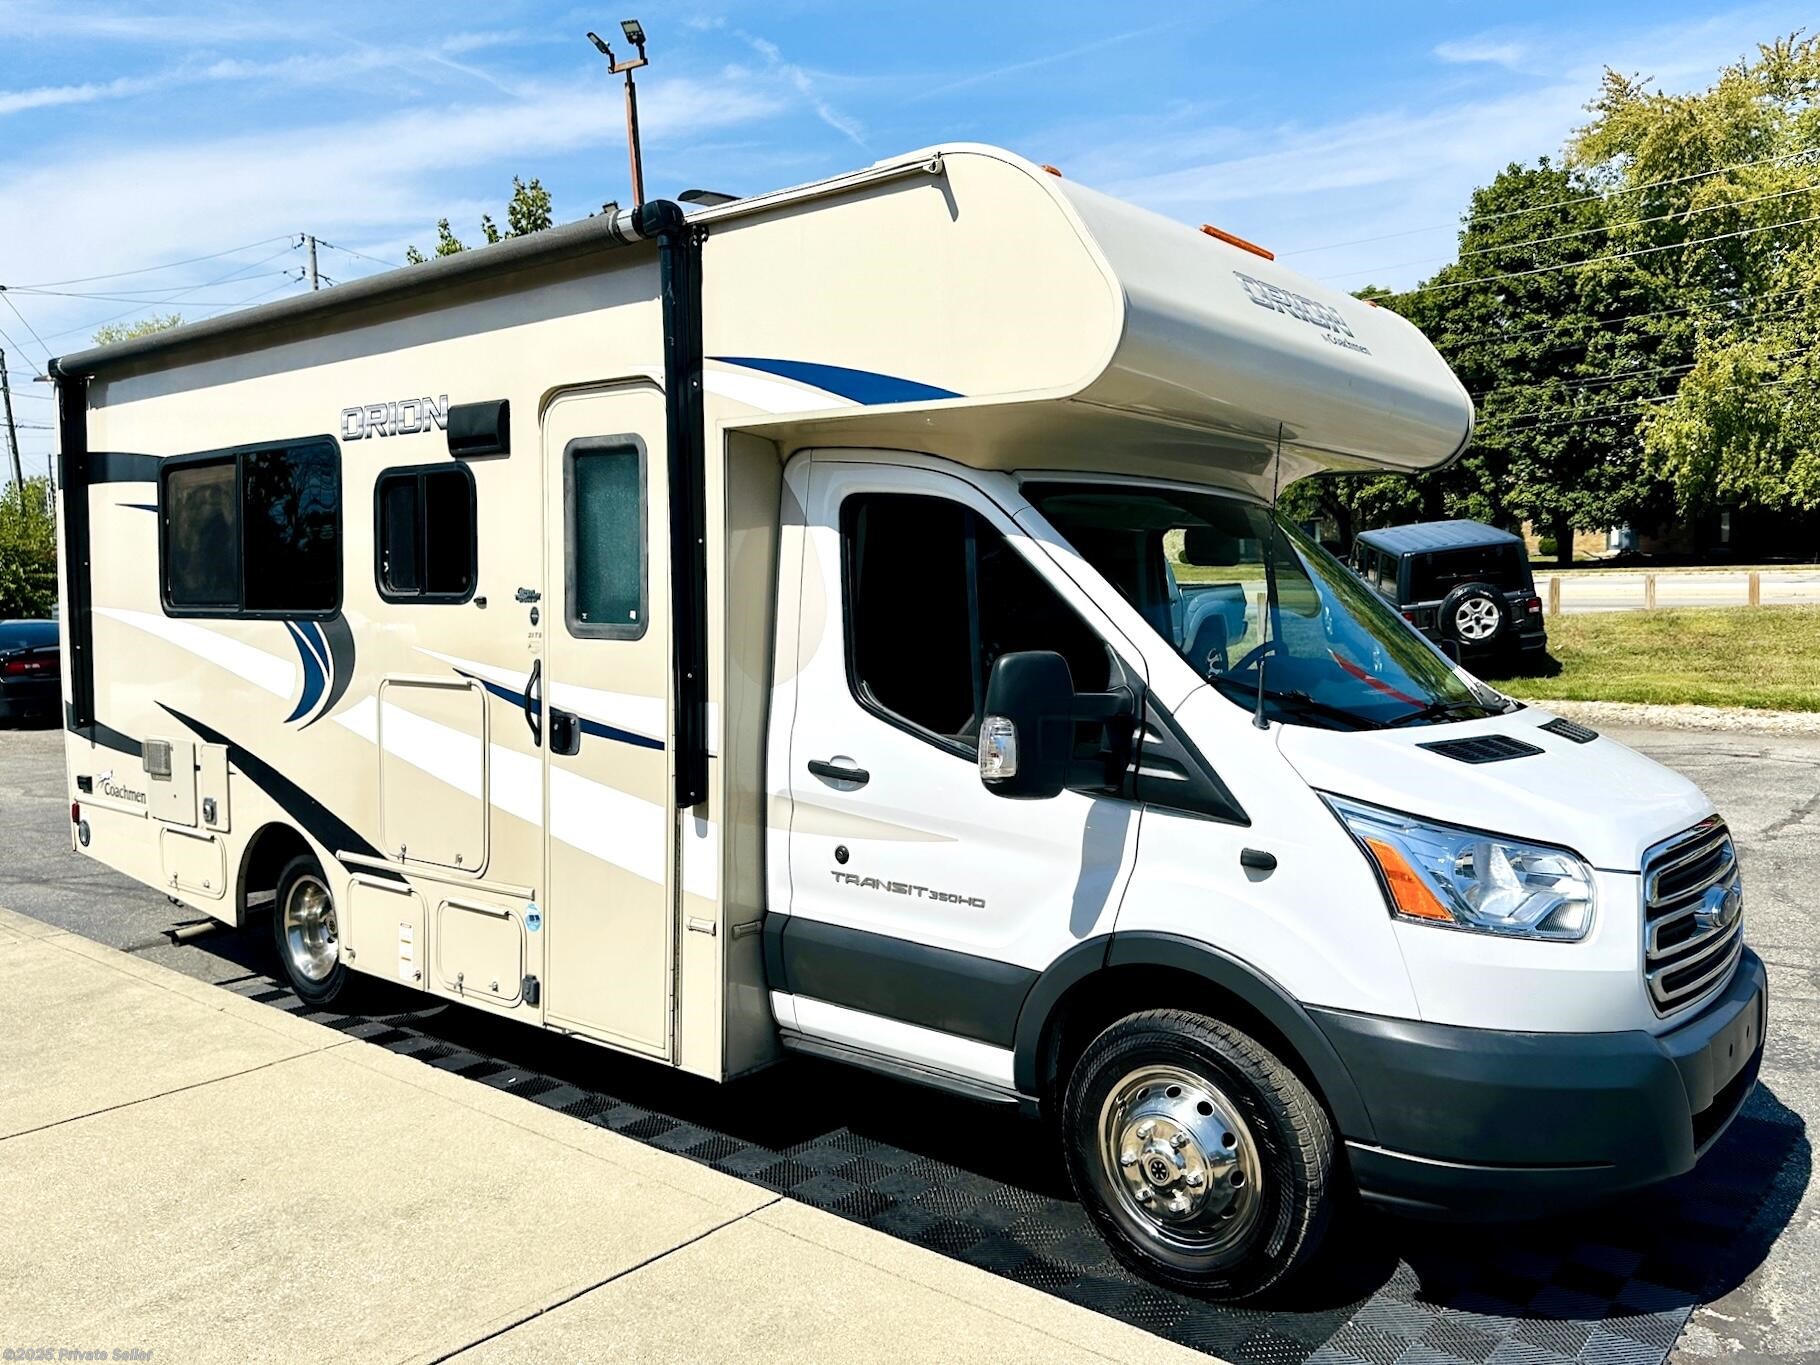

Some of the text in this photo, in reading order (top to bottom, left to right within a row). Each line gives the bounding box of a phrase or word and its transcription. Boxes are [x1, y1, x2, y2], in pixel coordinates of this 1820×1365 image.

[1232, 270, 1355, 339] ORION
[341, 394, 449, 442] ORION
[104, 782, 147, 804] Coachmen
[830, 870, 986, 909] TRANSIT 350HD
